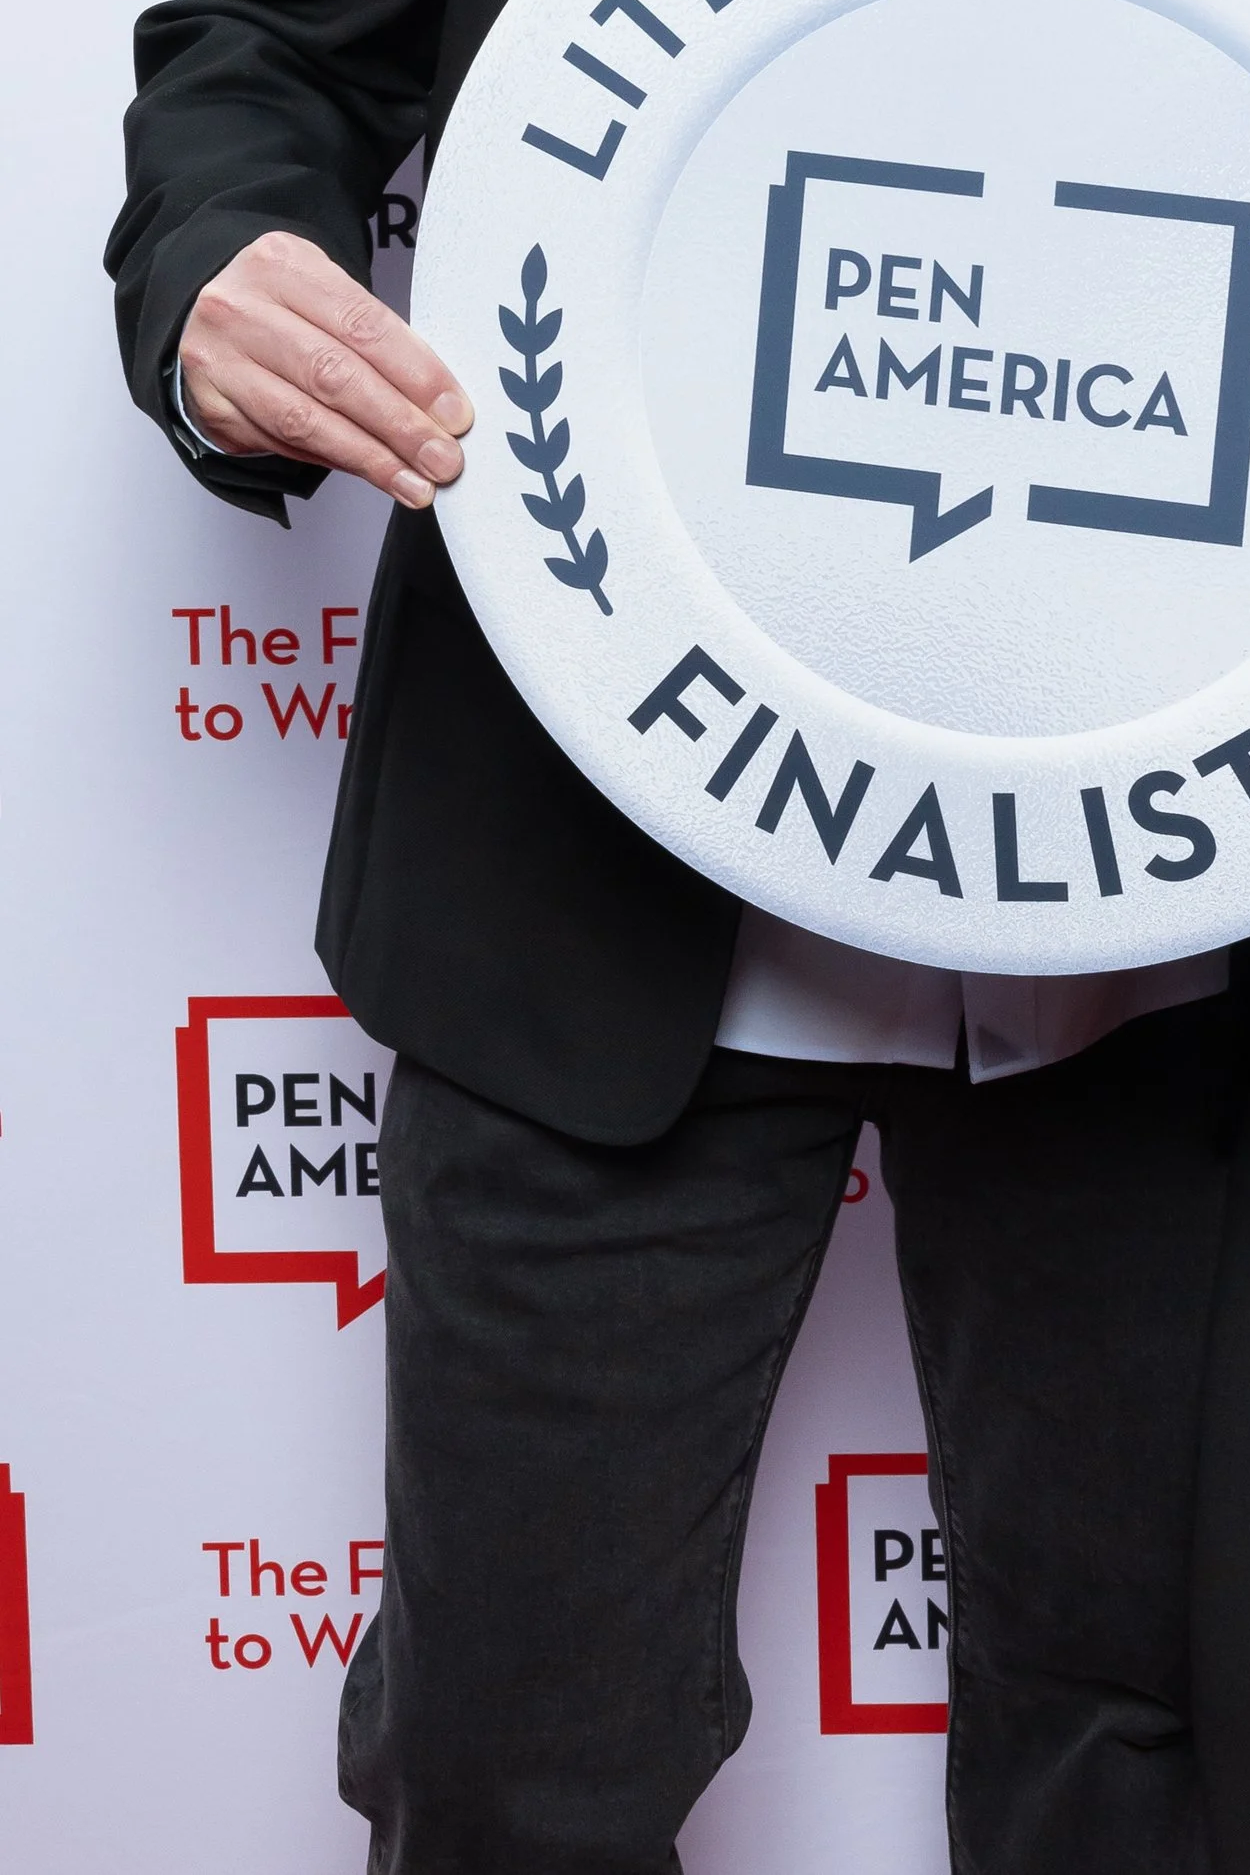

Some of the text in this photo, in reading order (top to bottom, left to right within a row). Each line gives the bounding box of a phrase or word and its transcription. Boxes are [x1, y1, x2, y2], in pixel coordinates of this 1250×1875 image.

[825, 248, 983, 327] PEN
[815, 333, 1187, 436] AMERICA
[172, 606, 299, 665] The
[176, 688, 243, 740] to
[236, 1072, 376, 1127] PEN
[202, 1539, 327, 1597] The
[873, 1528, 947, 1582] PE
[205, 1618, 271, 1669] to
